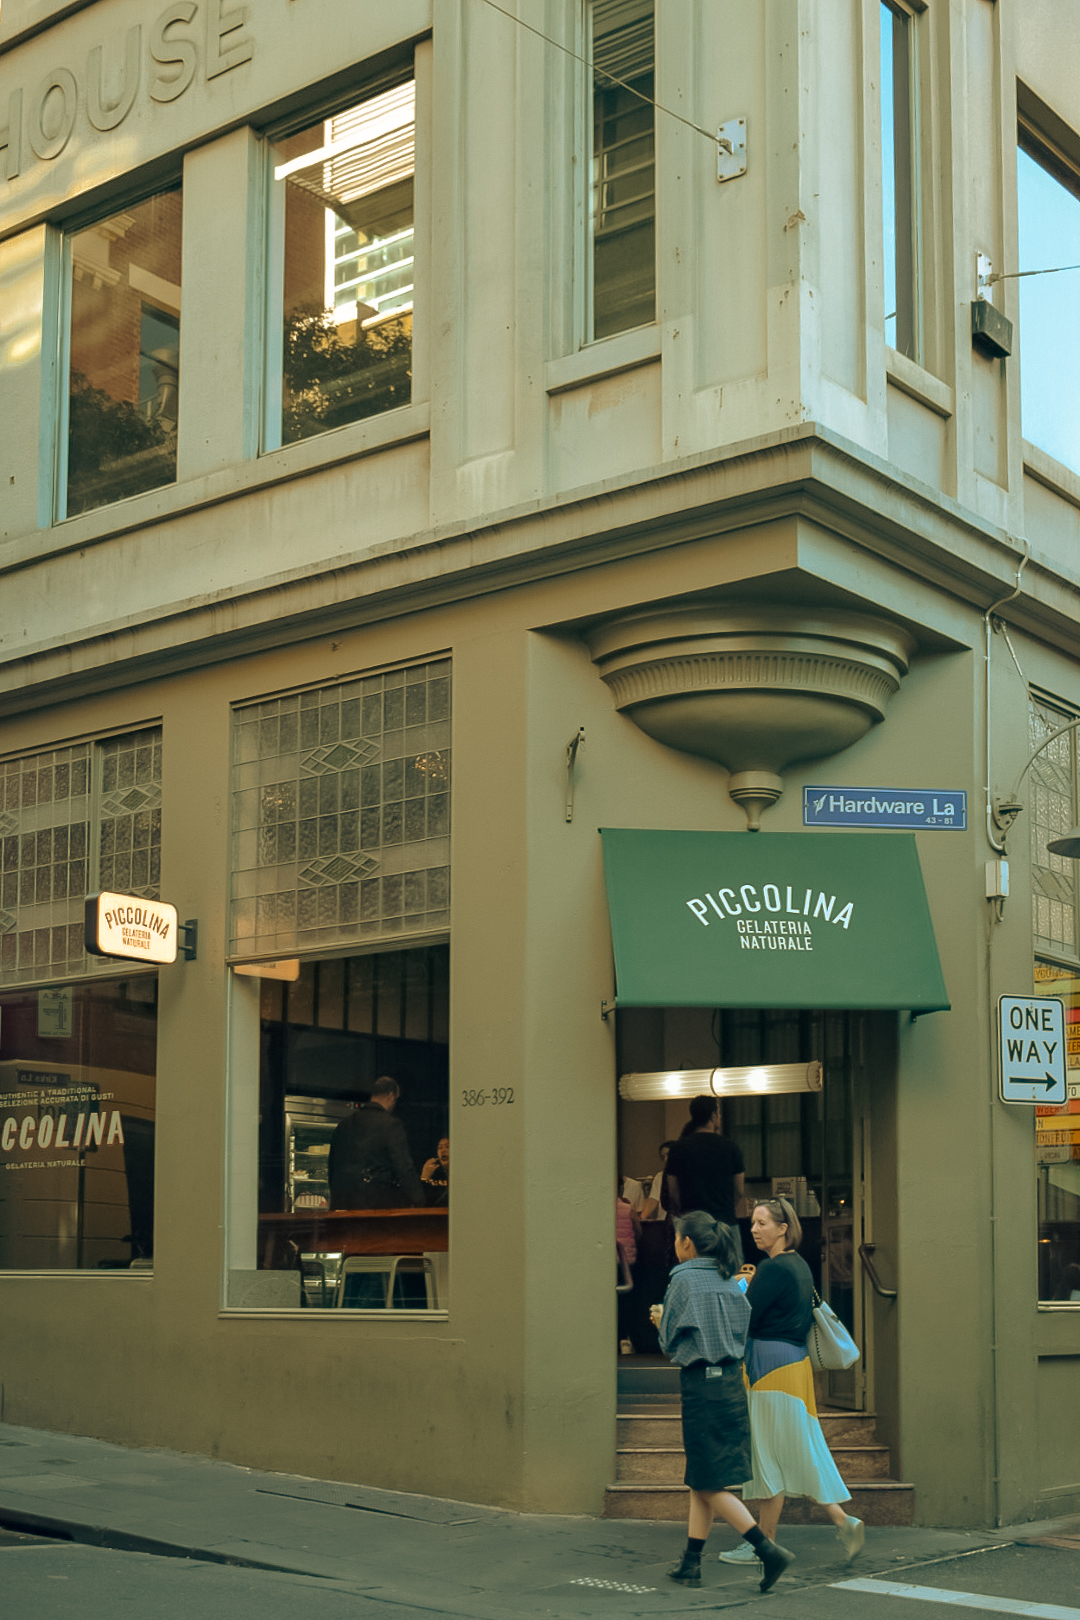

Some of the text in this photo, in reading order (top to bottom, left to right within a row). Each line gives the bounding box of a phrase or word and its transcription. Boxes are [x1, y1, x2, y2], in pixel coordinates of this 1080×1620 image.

[829, 795, 955, 816] Hardware La
[686, 884, 854, 930] PICCOLINA
[104, 906, 170, 940] PICCOLINA
[736, 920, 812, 935] GELATERIA
[122, 927, 151, 940] GELATERIA
[122, 936, 151, 950] NATURALE
[740, 935, 813, 951] NATURALE
[1009, 1005, 1054, 1031] ONE
[1007, 1038, 1058, 1064] WAY
[40, 1095, 79, 1105] ACCURATA
[91, 1092, 115, 1100] GUSTI
[48, 1086, 97, 1096] TRADITIONAL
[461, 1087, 515, 1107] 386-392
[1, 1110, 125, 1151] CCOLINA
[5, 1159, 85, 1170] GELATERIA NATURALE
